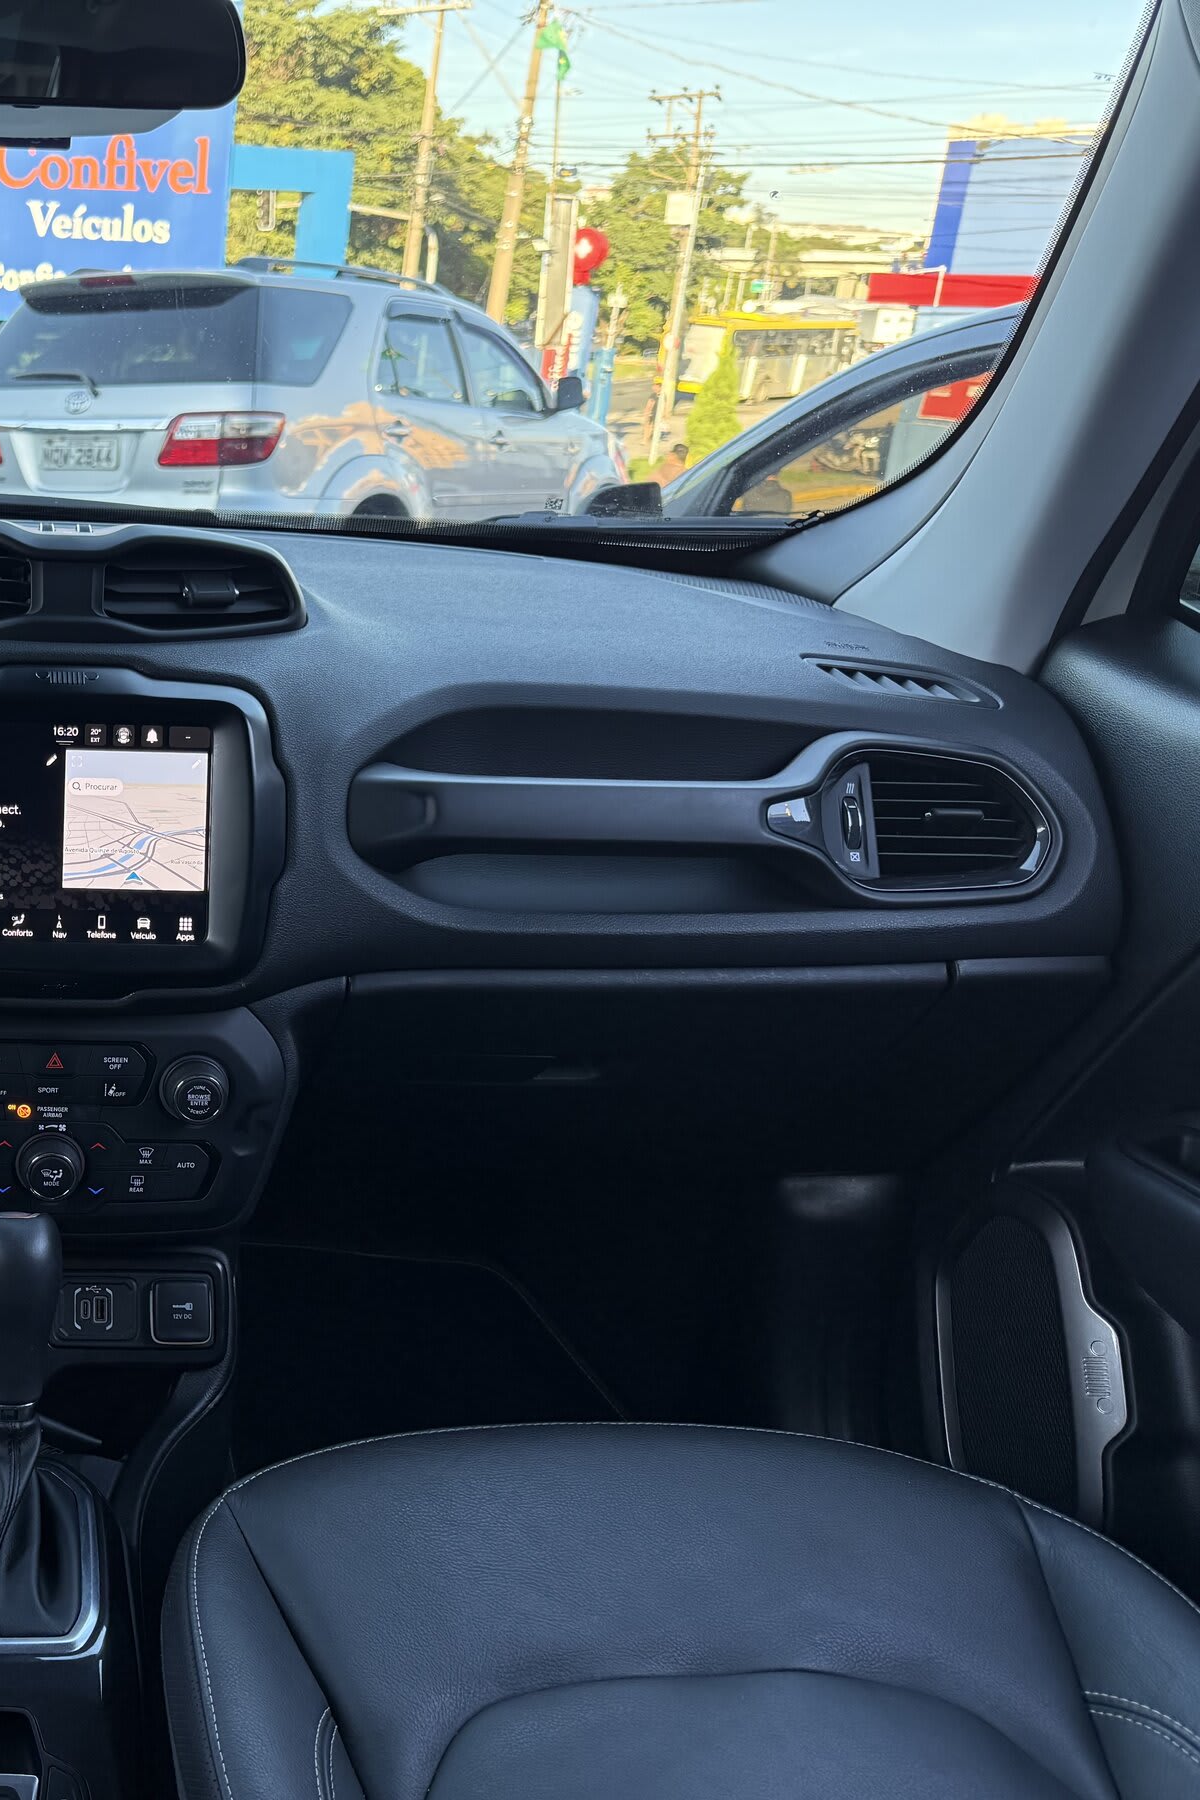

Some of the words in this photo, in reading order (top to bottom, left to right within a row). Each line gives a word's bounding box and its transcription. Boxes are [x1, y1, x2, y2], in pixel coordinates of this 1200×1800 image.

[26, 199, 171, 244] Veículos
[53, 725, 79, 737] 16:20
[85, 783, 118, 791] Procurar
[1, 928, 34, 937] Conforto
[52, 930, 68, 939] Nav
[86, 930, 116, 939] Telefone
[130, 931, 156, 940] Veículo
[175, 932, 195, 942] Apps
[103, 1056, 129, 1064] SCREEN
